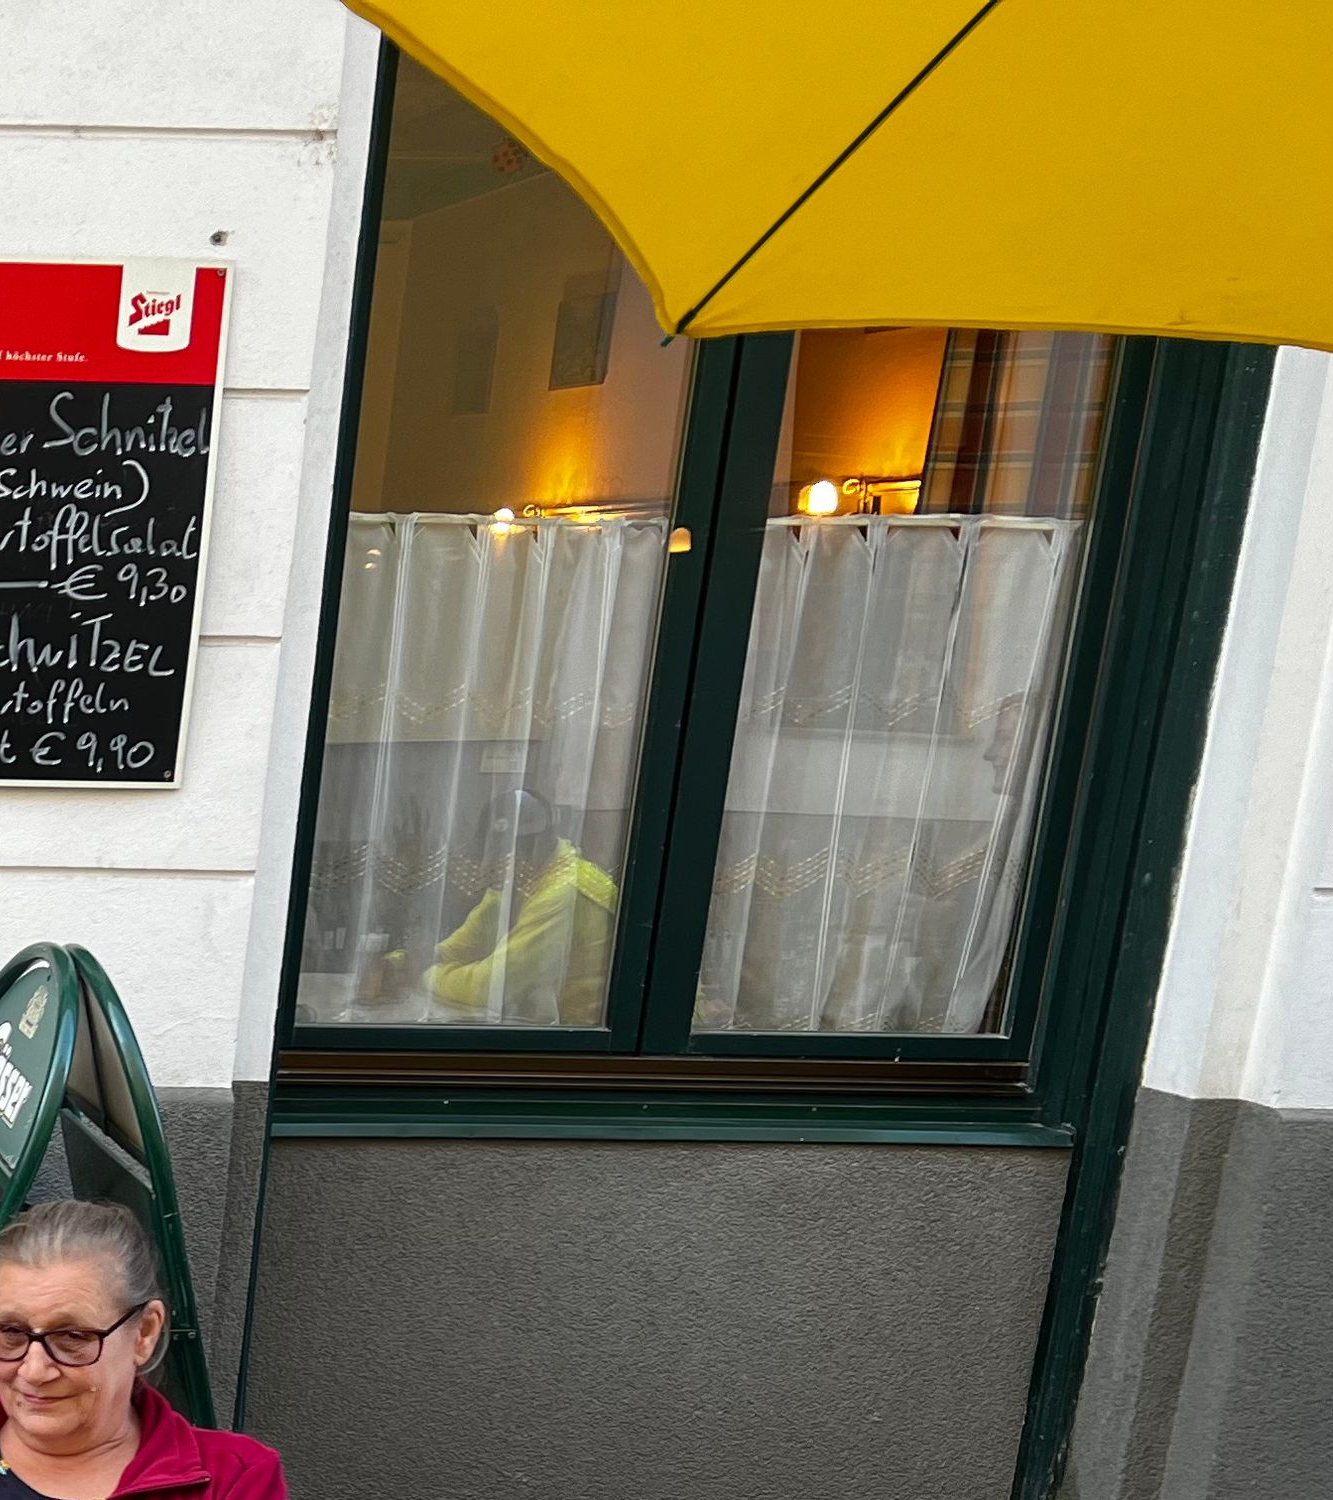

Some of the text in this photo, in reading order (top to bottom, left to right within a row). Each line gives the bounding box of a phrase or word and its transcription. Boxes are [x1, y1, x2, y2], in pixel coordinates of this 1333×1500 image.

[127, 292, 182, 327] Stiegl
[5, 350, 53, 362] höchster
[42, 391, 210, 458] Schnitzel
[50, 563, 187, 607] € 9,30
[30, 732, 66, 766] €
[76, 731, 155, 773] 9,90
